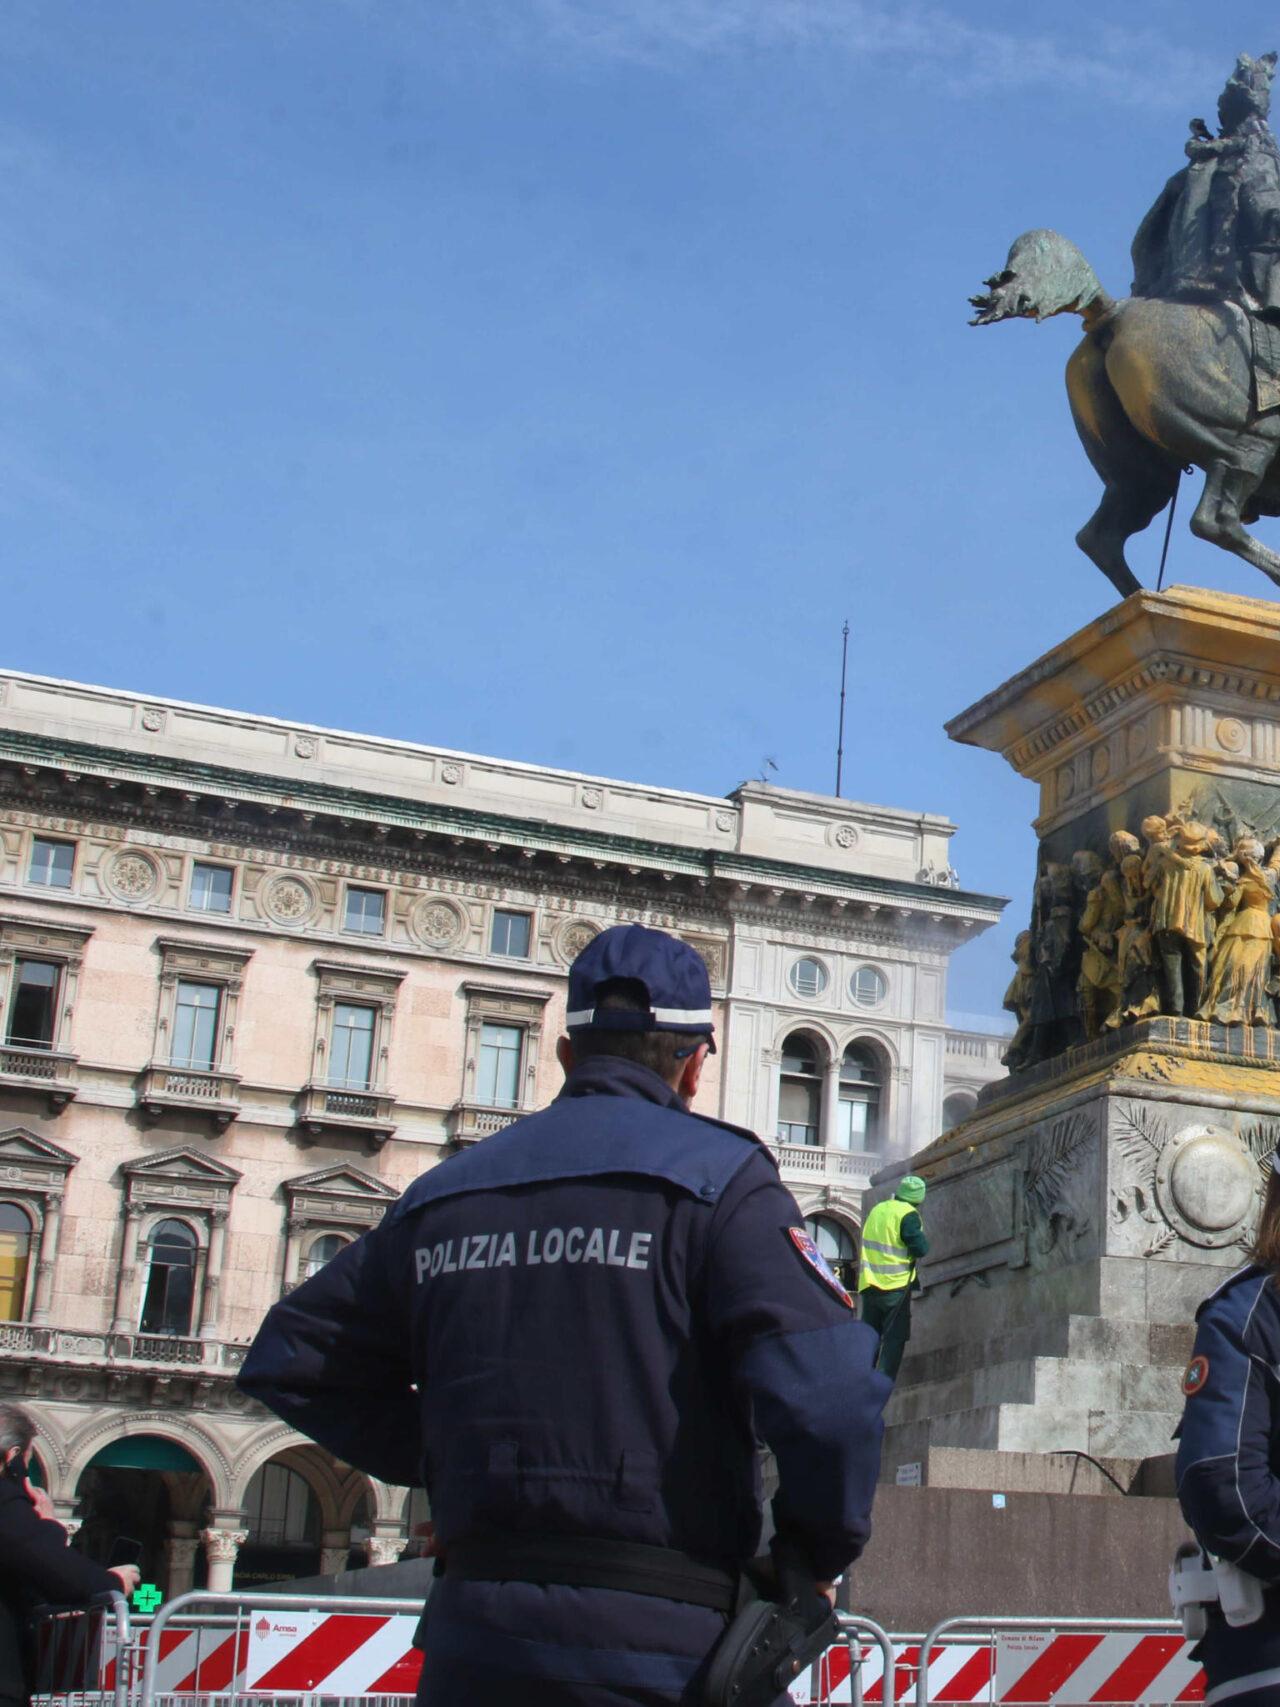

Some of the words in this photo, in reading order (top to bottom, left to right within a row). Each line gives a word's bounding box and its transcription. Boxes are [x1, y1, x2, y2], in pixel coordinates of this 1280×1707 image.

[414, 1231, 517, 1284] POLIZIA
[526, 1226, 652, 1270] LOCALE
[273, 1624, 298, 1632] Amsa
